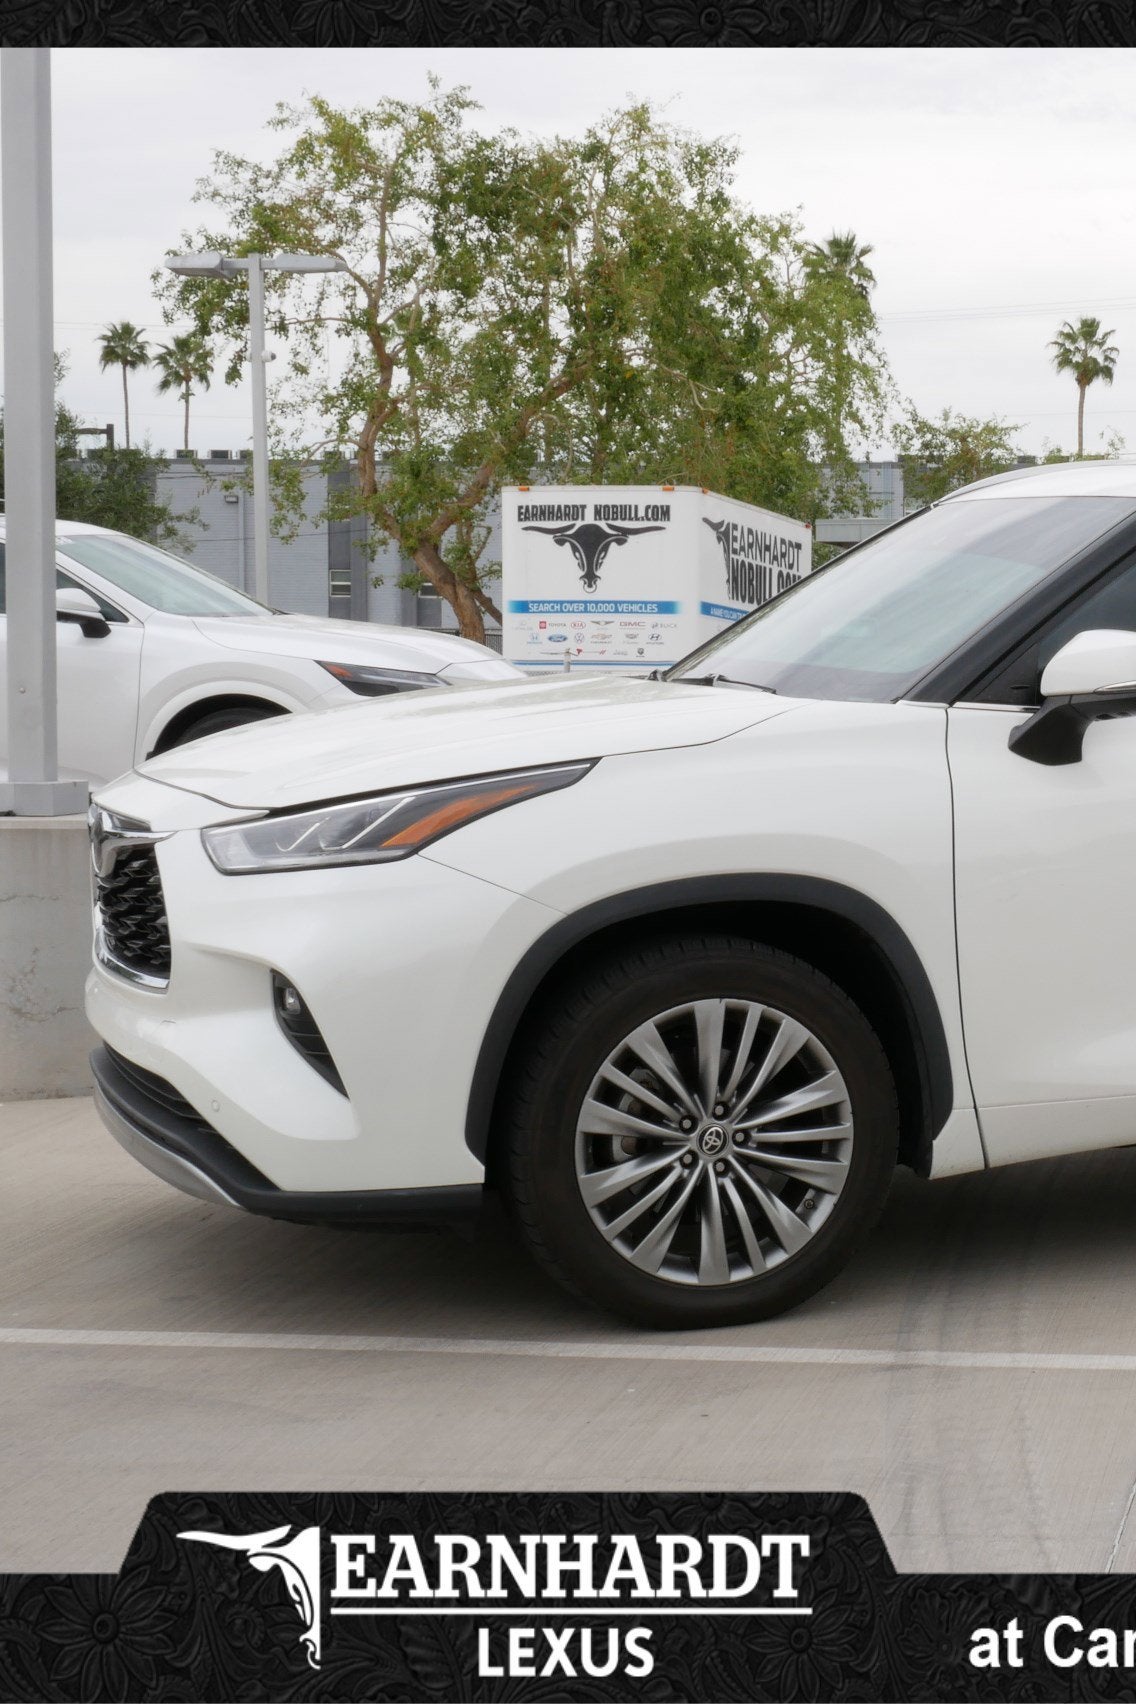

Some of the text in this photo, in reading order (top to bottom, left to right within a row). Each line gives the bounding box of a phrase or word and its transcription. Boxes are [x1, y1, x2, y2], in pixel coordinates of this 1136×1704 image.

[518, 504, 671, 522] EARNHARDT NOBULL.COM
[731, 522, 802, 572] EARNHARDT
[528, 602, 658, 613] SEARCH OVER 10,000 VEHICLES
